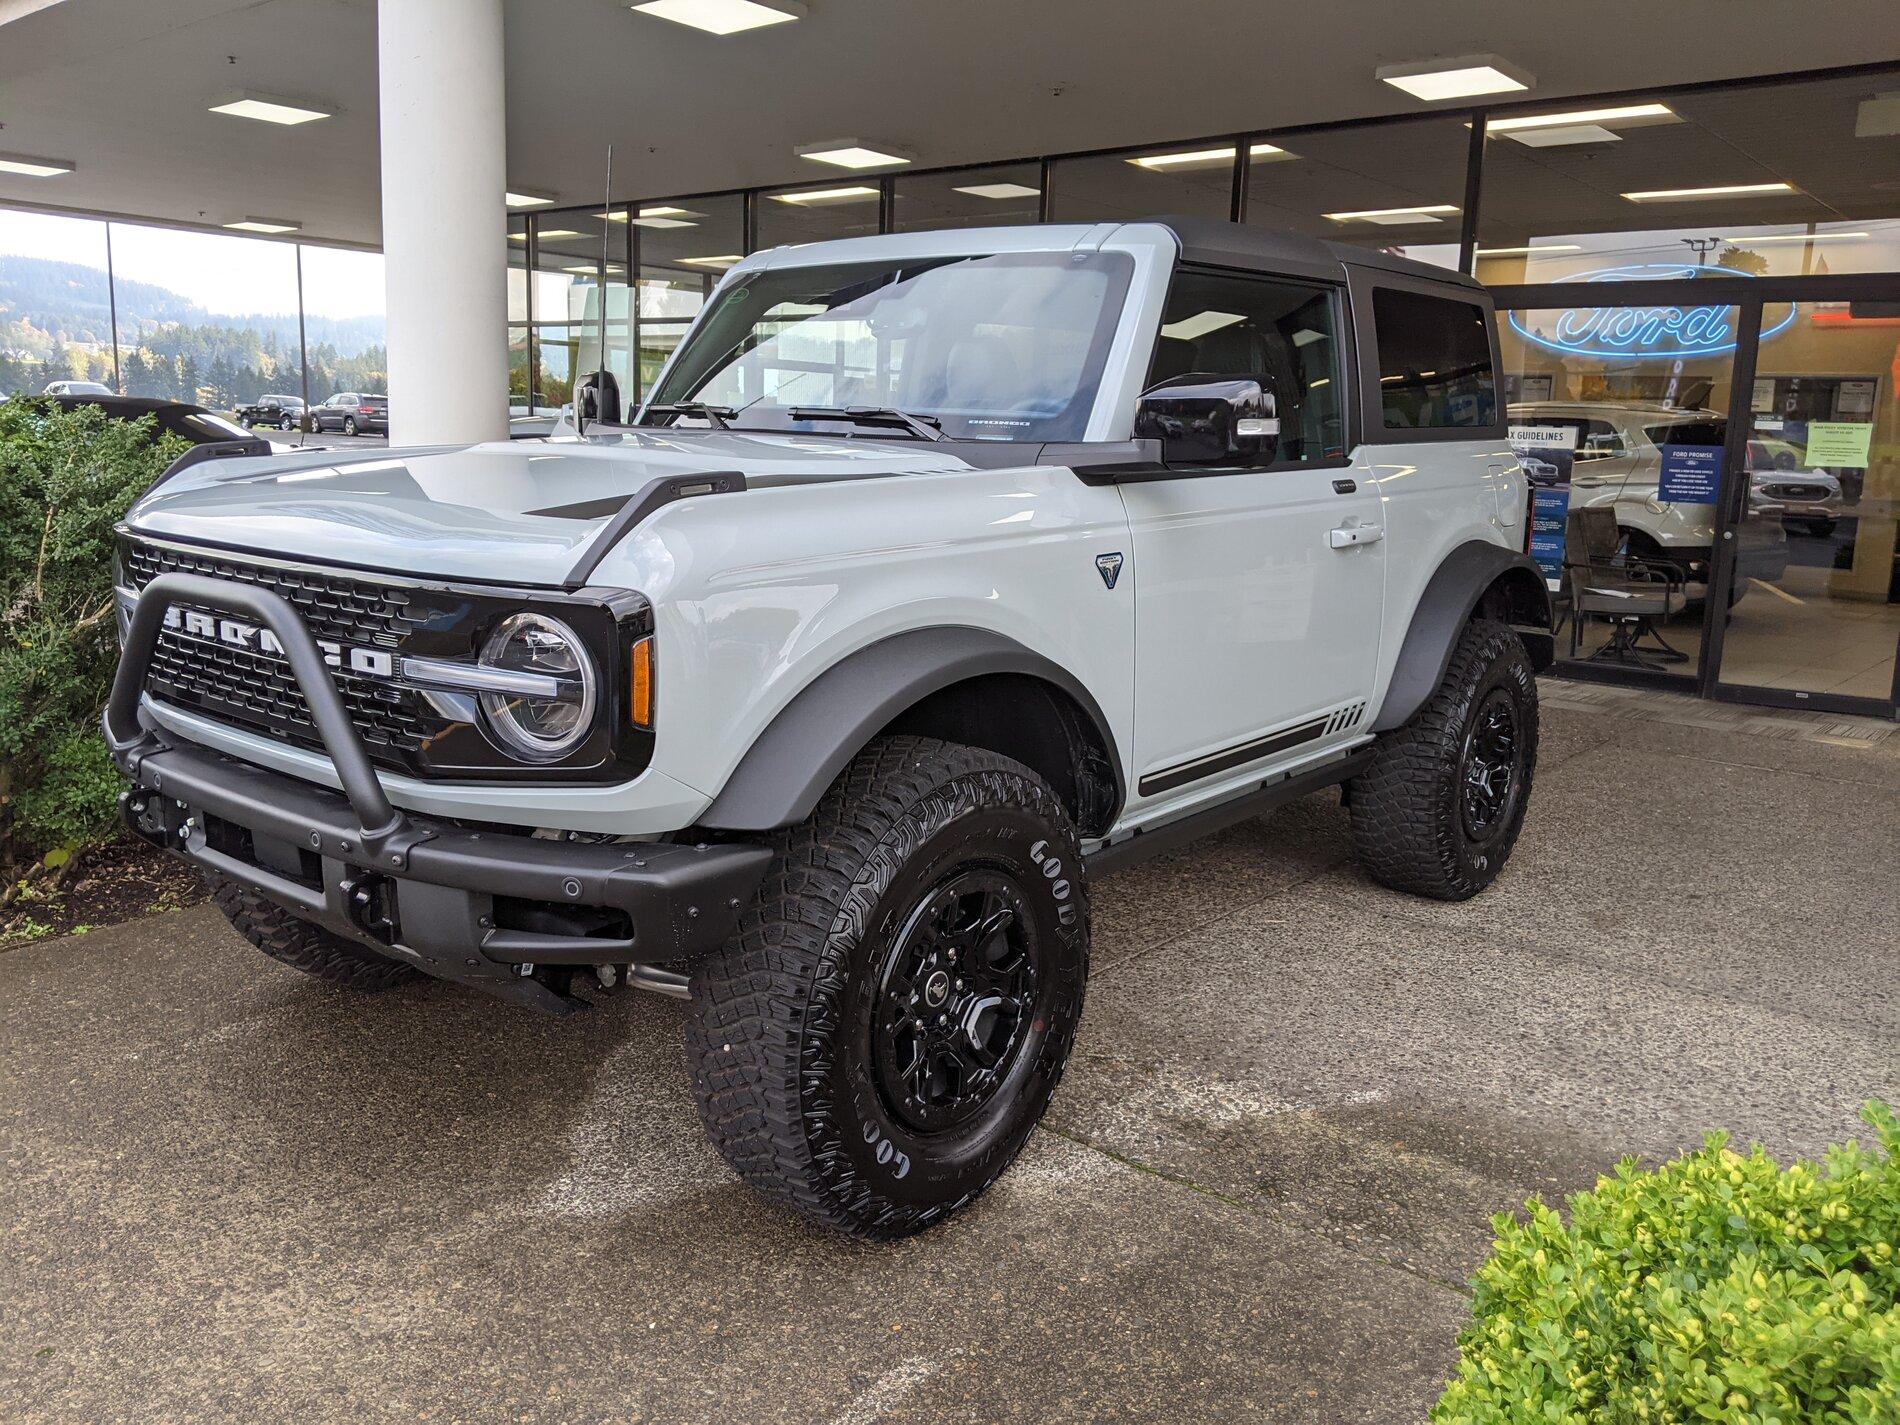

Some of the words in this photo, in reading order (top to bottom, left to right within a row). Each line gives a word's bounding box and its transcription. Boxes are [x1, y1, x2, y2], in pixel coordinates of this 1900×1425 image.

[1556, 268, 1730, 346] Ford
[1517, 431, 1564, 441] GUIDELINES
[1688, 451, 1713, 459] PROMISE
